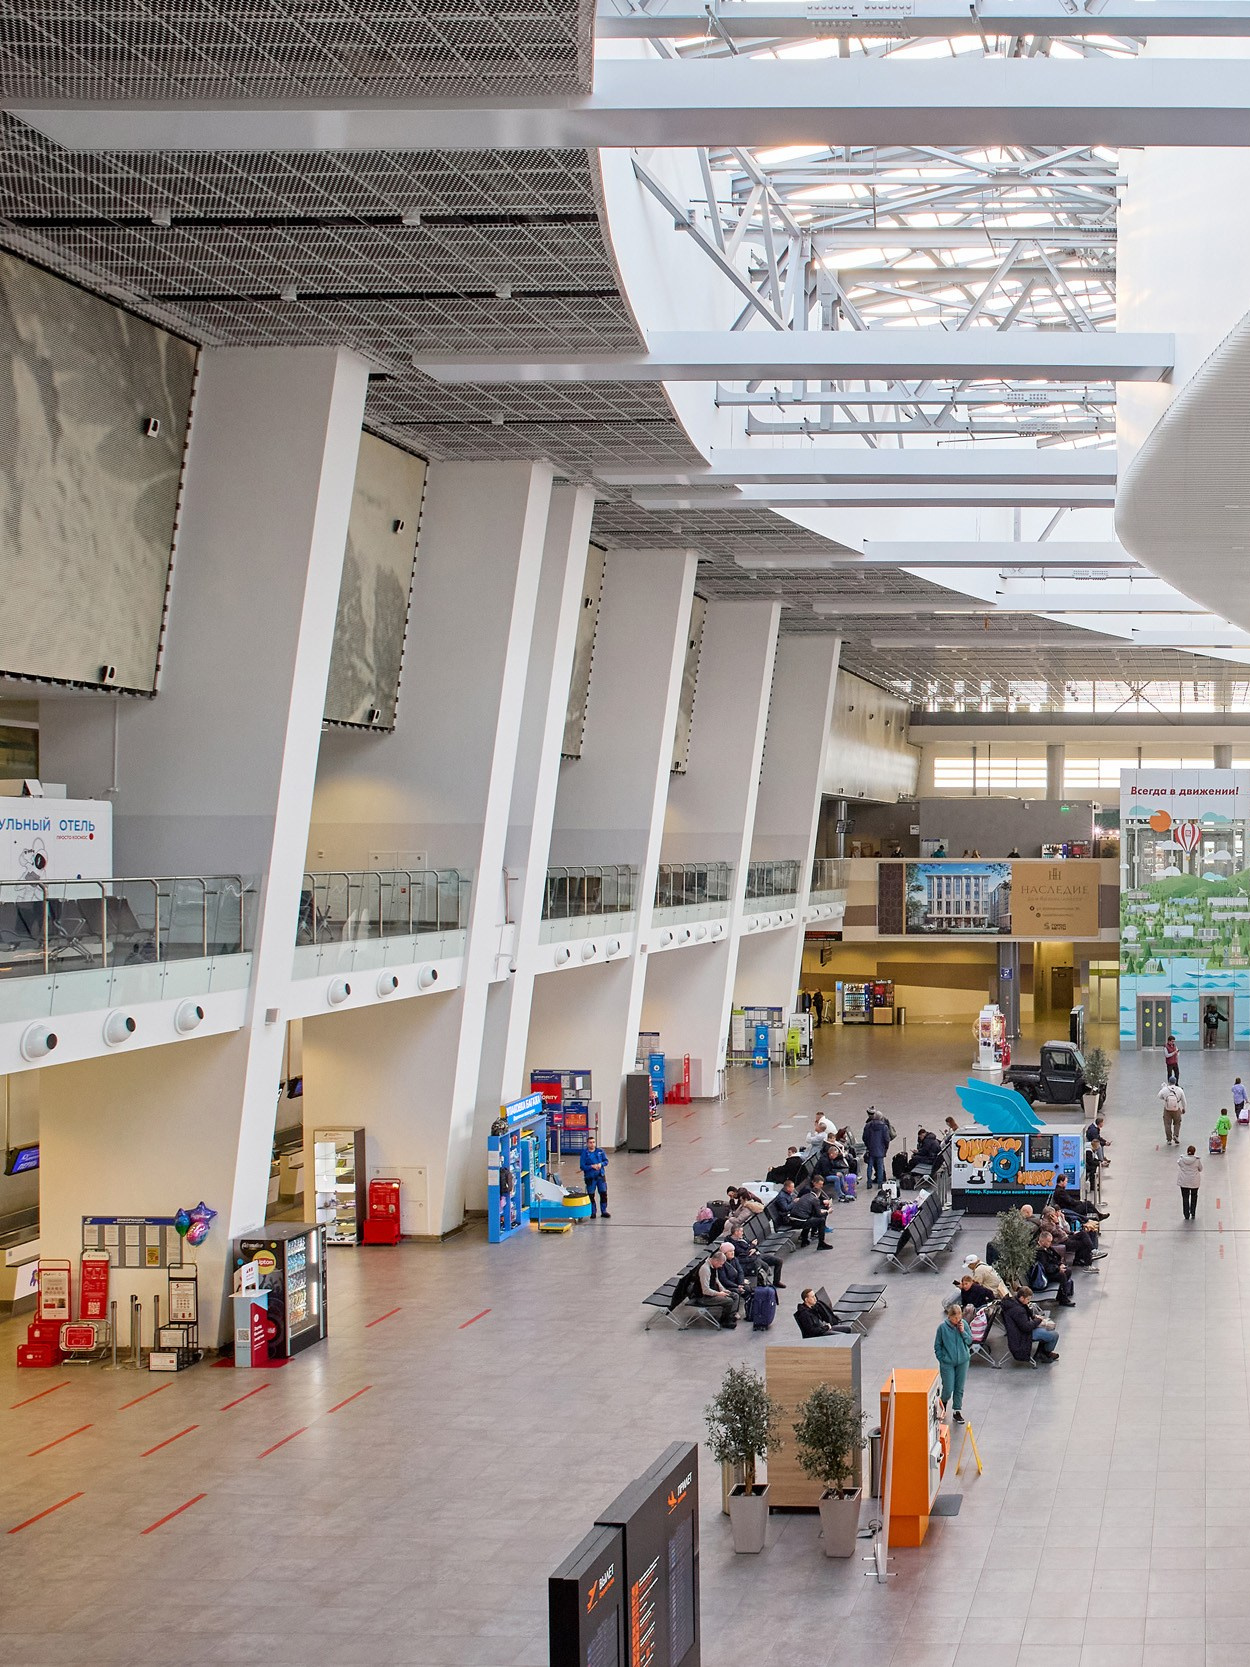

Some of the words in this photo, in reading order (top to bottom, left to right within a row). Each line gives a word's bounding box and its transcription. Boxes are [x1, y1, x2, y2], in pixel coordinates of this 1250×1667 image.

[1131, 786, 1167, 797] Всегда
[1179, 786, 1239, 797] движении!
[0, 816, 51, 831] УЛЬНЫЙ
[59, 819, 96, 832] ОТЕЛЬ
[1021, 885, 1089, 895] НАСЛЕДИЕ
